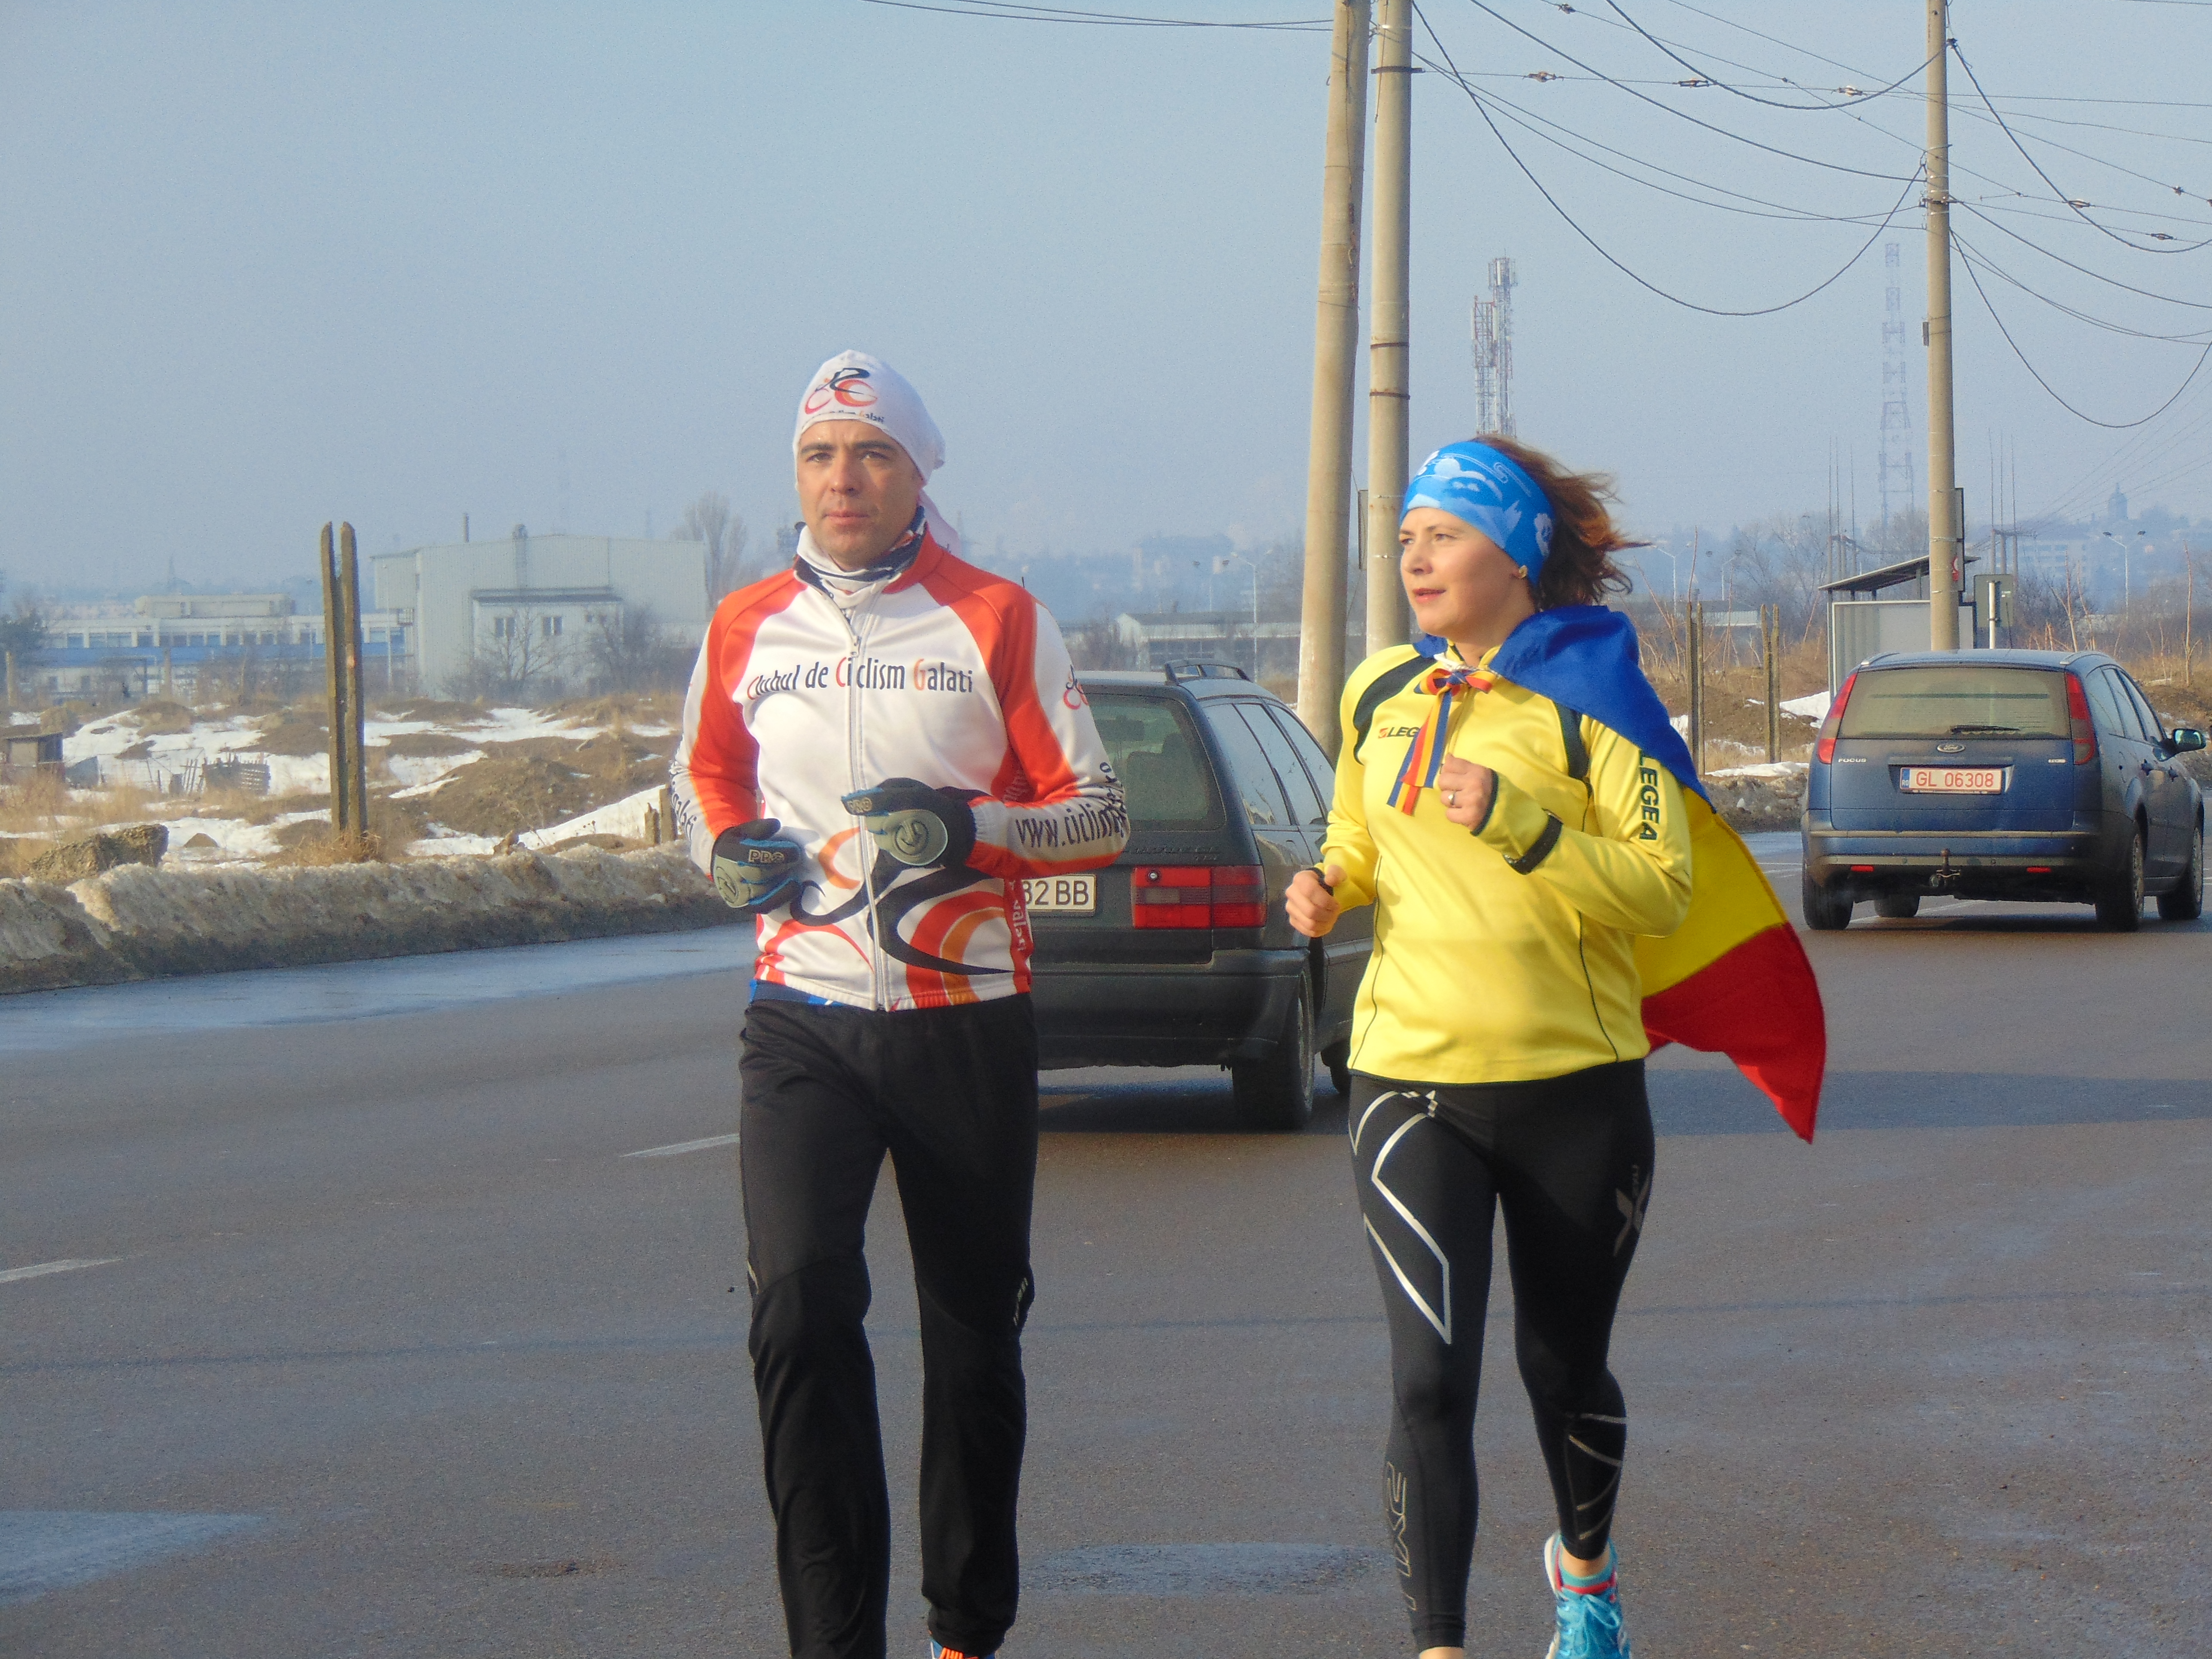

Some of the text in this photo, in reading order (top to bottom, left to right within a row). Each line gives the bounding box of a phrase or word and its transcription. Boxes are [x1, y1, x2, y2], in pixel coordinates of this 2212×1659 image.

[747, 657, 973, 700] Clubul de Ciclism Galati
[1916, 772, 1994, 787] GL 06308
[1055, 880, 1088, 905] BB
